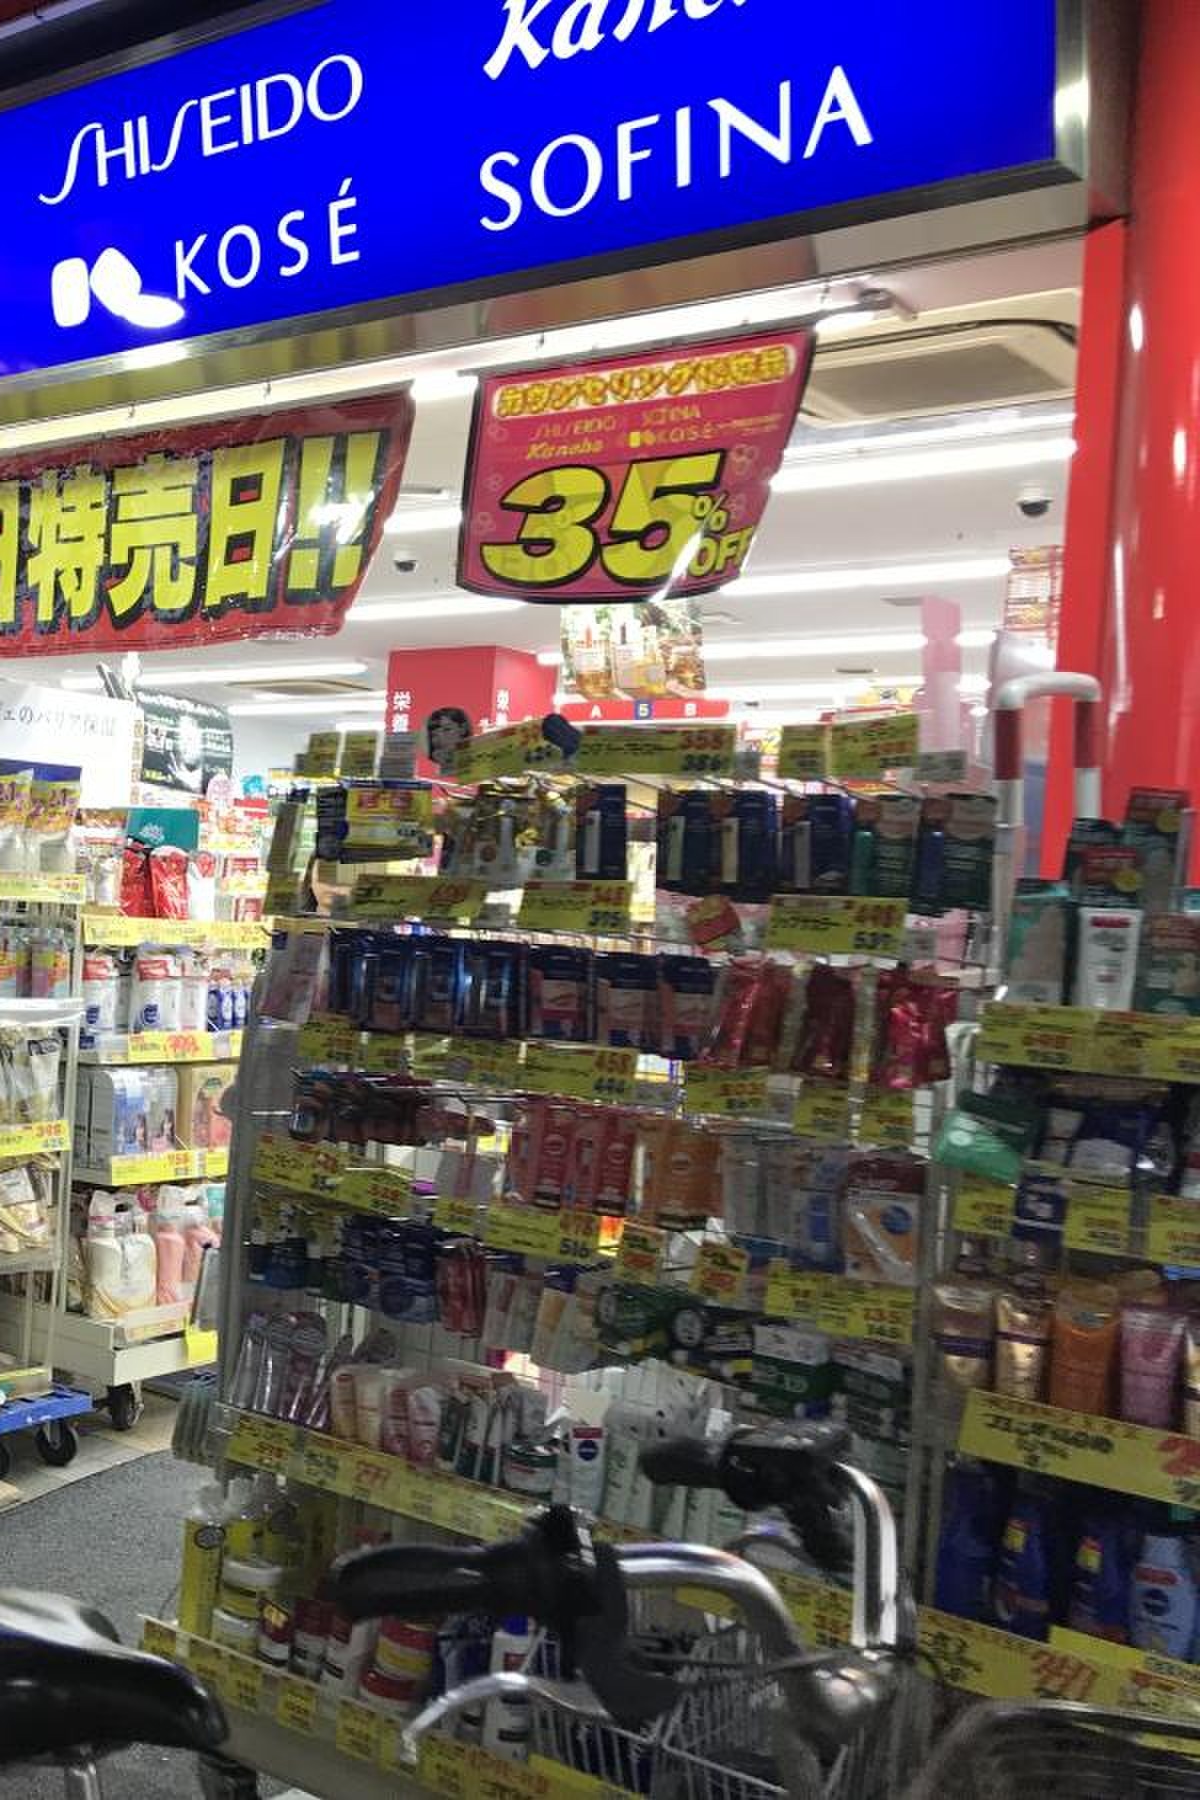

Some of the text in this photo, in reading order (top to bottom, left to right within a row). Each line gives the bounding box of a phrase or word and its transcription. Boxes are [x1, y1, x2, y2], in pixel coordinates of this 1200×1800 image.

[483, 0, 746, 80] Kan
[37, 54, 363, 205] SHISEIDO
[478, 65, 873, 231] SOFINA
[176, 178, 360, 300] KOSÉ
[590, 704, 602, 717] A
[638, 703, 650, 718] 5
